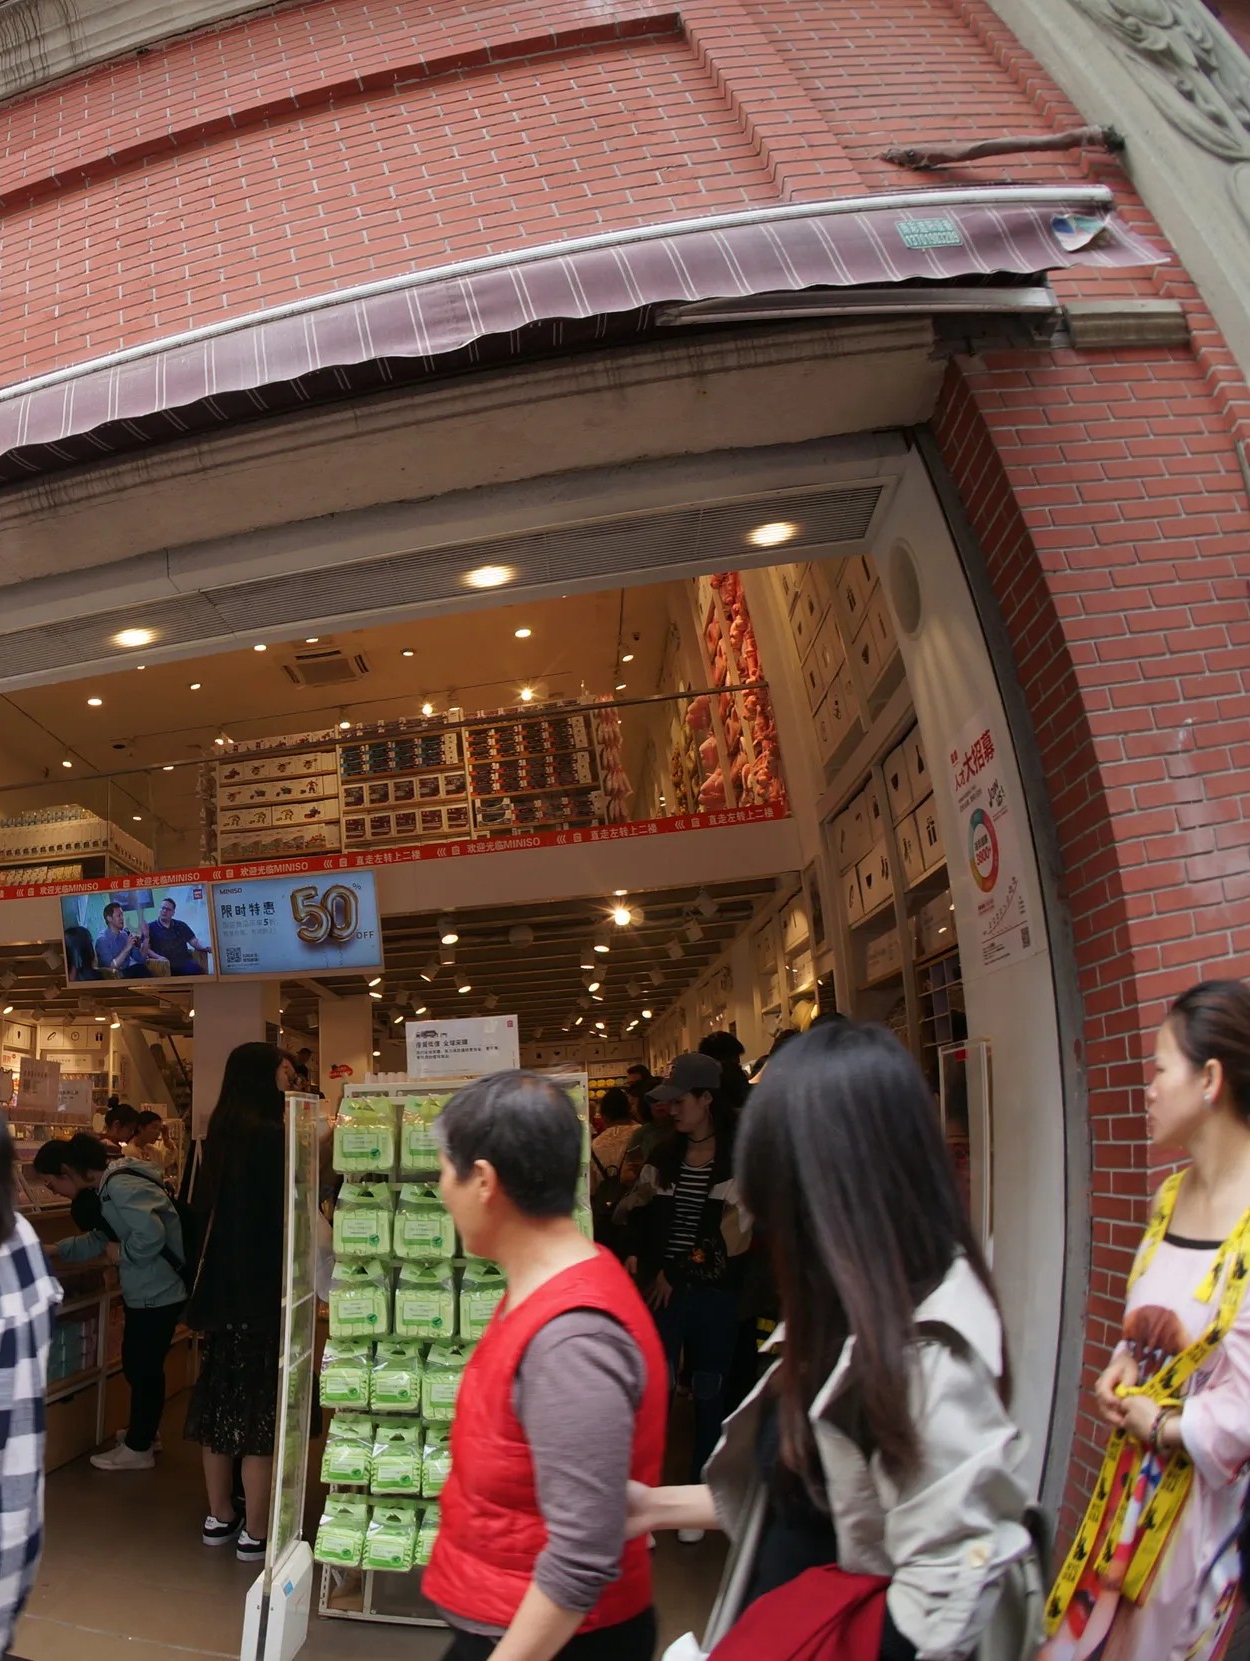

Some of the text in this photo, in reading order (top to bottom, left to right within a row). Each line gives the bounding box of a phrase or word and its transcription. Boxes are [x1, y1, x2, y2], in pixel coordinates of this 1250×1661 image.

[708, 807, 774, 826] 直走左转上二楼
[590, 823, 658, 842] 直走左转上二楼
[467, 837, 541, 854] 欢迎光临MINISO
[356, 850, 421, 867] 直走左转上二楼
[240, 861, 309, 878] 欢迎光临MINISO
[136, 872, 200, 887] 欢迎光临MINISO
[40, 882, 99, 896] 欢迎光临MINISO
[219, 887, 243, 896] MINISO
[221, 901, 276, 919] 限时特惠
[290, 883, 358, 942] 50
[356, 930, 375, 940] OFF
